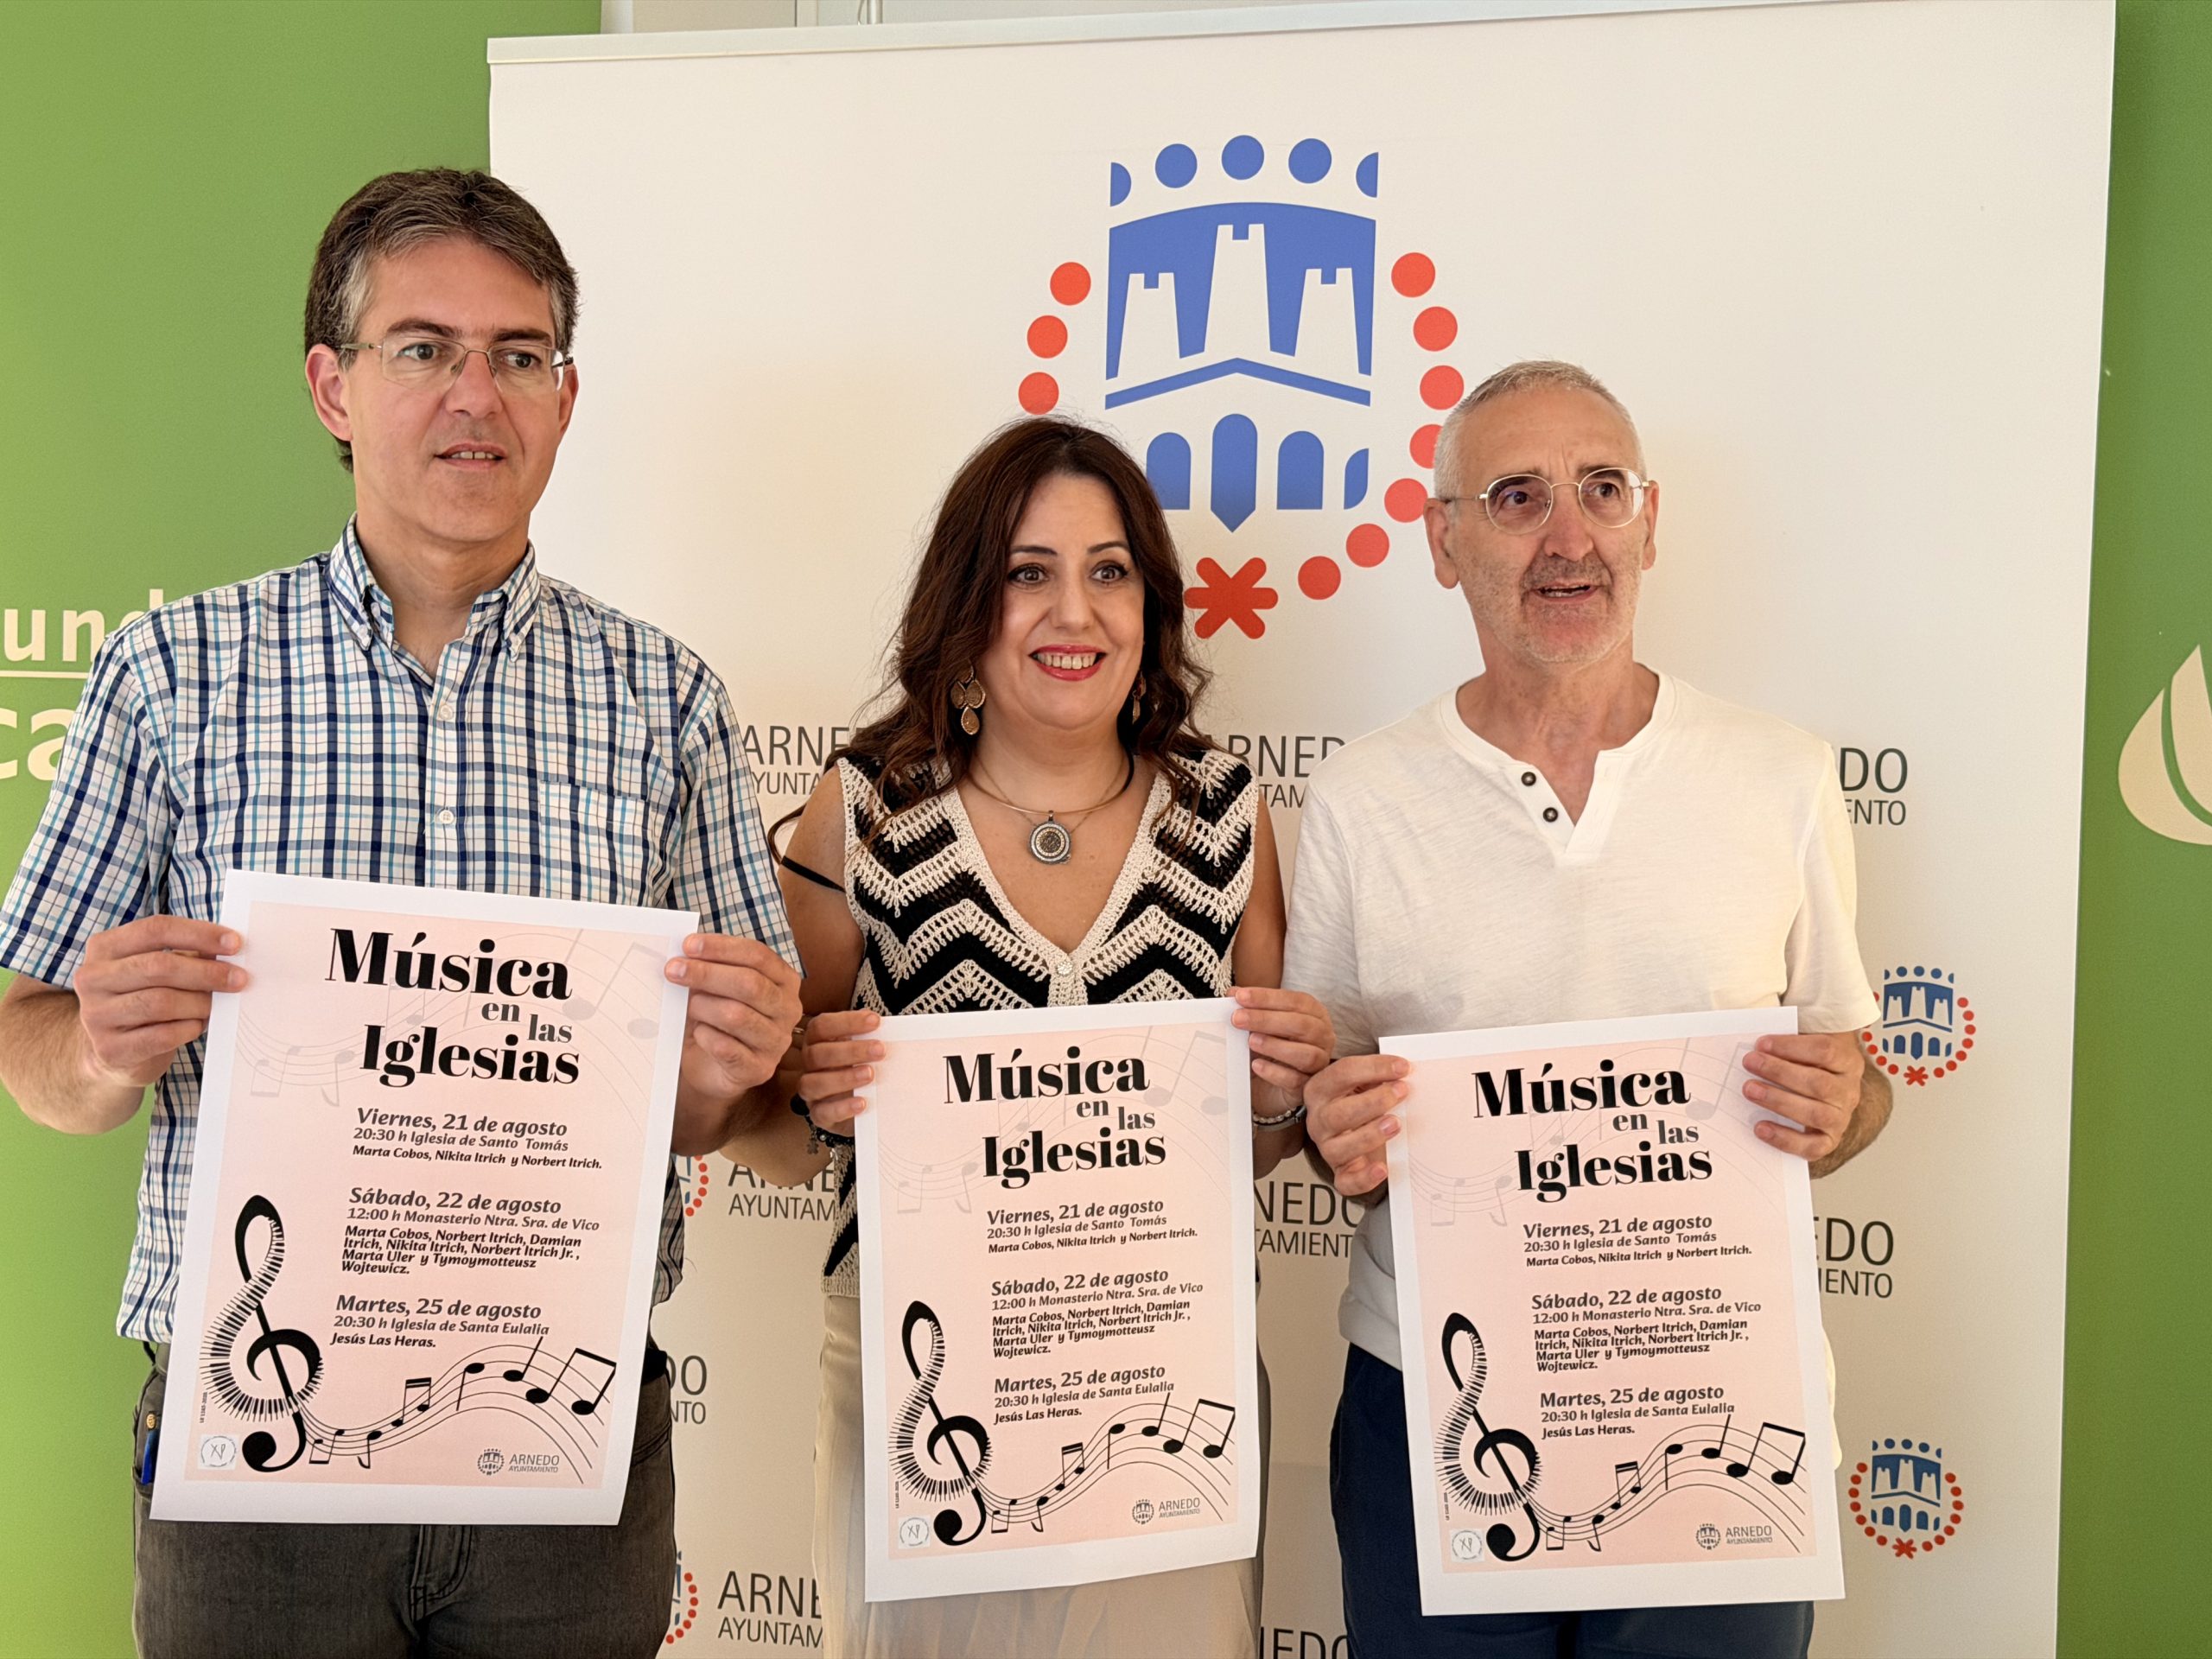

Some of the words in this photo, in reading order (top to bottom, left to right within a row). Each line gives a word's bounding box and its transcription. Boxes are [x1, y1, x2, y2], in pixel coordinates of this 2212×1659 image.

[743, 725, 868, 766] ARNE
[324, 928, 572, 1000] Música
[481, 1002, 519, 1021] en
[528, 1014, 571, 1043] las
[359, 1024, 579, 1087] Iglesias
[943, 1046, 1149, 1103] Música
[1471, 1058, 1690, 1118] Música
[356, 1107, 436, 1131] Viernes,
[442, 1113, 467, 1130] 21
[473, 1116, 498, 1132] de
[501, 1121, 567, 1141] agosto
[1076, 1100, 1109, 1117] en
[1117, 1106, 1154, 1129] las
[353, 1127, 395, 1141] 20:30
[397, 1130, 407, 1141] h
[410, 1131, 456, 1146] Iglesia
[459, 1134, 476, 1146] de
[478, 1135, 518, 1147] Santo
[525, 1138, 568, 1151] Tomás
[1612, 1113, 1647, 1131] en
[1657, 1119, 1698, 1144] las
[353, 1144, 391, 1156] Marta
[393, 1147, 431, 1161] Cobos,
[435, 1149, 472, 1161] Nikita
[474, 1152, 505, 1163] Itrich
[510, 1156, 518, 1166] y
[521, 1154, 566, 1166] Norbert
[569, 1157, 601, 1168] Itrich.
[982, 1126, 1166, 1189] Iglesias
[1515, 1141, 1712, 1203] Iglesias
[349, 1186, 430, 1210] Sábado,
[435, 1192, 462, 1208] 22
[467, 1193, 492, 1210] de
[495, 1198, 561, 1216] agosto
[987, 1209, 1053, 1225] Viernes,
[1058, 1204, 1080, 1219] 21
[1084, 1202, 1104, 1217] de
[1109, 1200, 1163, 1218] agosto
[346, 1207, 388, 1220] 12:00
[391, 1209, 400, 1221] h
[404, 1210, 480, 1224] Monasterio
[484, 1213, 518, 1226] Ntra.
[521, 1216, 547, 1228] Sra.
[551, 1217, 568, 1229] de
[572, 1218, 599, 1230] Vico
[987, 1226, 1020, 1238] 20:30
[1024, 1225, 1031, 1236] h
[1034, 1222, 1071, 1237] Iglesia
[1074, 1221, 1088, 1231] de
[1090, 1219, 1124, 1230] Santo
[1129, 1214, 1166, 1227] Tomás
[1522, 1223, 1595, 1236] Viernes,
[1599, 1218, 1622, 1234] 21
[1626, 1217, 1648, 1232] de
[1652, 1216, 1712, 1234] agosto
[343, 1236, 382, 1251] Itrich,
[385, 1238, 427, 1251] Nikita
[429, 1240, 467, 1255] Itrich,
[470, 1243, 521, 1255] Norbert
[524, 1244, 558, 1257] Itrich
[345, 1224, 386, 1237] Marta
[387, 1227, 431, 1243] Cobos,
[435, 1229, 486, 1243] Norbert
[488, 1231, 525, 1246] Itrich,
[526, 1233, 581, 1247] Damian
[1255, 1228, 1353, 1258] AMIENT
[1523, 1240, 1560, 1252] 20:30
[1562, 1239, 1570, 1249] h
[1573, 1236, 1613, 1251] Iglesia
[1616, 1236, 1631, 1247] de
[1634, 1235, 1670, 1245] Santo
[1675, 1231, 1716, 1243] Tomás
[1813, 1216, 1894, 1266] DO
[341, 1248, 384, 1261] Marta
[419, 1255, 429, 1266] y
[991, 1277, 1058, 1296] Sábado,
[1064, 1274, 1085, 1289] 22
[1089, 1272, 1109, 1287] de
[1113, 1269, 1168, 1288] agosto
[335, 1294, 410, 1317] Martes,
[415, 1298, 442, 1314] 25
[447, 1299, 471, 1315] de
[475, 1305, 541, 1320] agosto
[992, 1297, 1026, 1310] 12:00
[1028, 1296, 1035, 1306] h
[1039, 1291, 1103, 1306] Monasterio
[1106, 1289, 1135, 1300] Ntra.
[1137, 1287, 1160, 1297] Sra.
[1162, 1284, 1176, 1294] de
[1179, 1282, 1203, 1293] Vico
[1531, 1292, 1603, 1311] Sábado,
[1608, 1289, 1631, 1305] 22
[1636, 1288, 1656, 1303] de
[1661, 1287, 1721, 1306] agosto
[1533, 1312, 1568, 1324] 12:00
[1571, 1311, 1579, 1321] h
[1582, 1306, 1651, 1320] Monasterio
[1654, 1306, 1685, 1317] Ntra.
[1688, 1304, 1713, 1315] Sra.
[1716, 1302, 1731, 1313] de
[1734, 1301, 1761, 1312] Vico
[334, 1315, 375, 1328] 20:30
[378, 1316, 387, 1328] h
[391, 1318, 436, 1332] Iglesia
[439, 1319, 456, 1332] de
[458, 1320, 499, 1332] Santa
[502, 1322, 549, 1336] Eulalia
[329, 1332, 365, 1345] Jesús
[368, 1333, 391, 1345] Las
[394, 1335, 435, 1347] Heras.
[994, 1377, 1056, 1393] Martes,
[1060, 1370, 1082, 1387] 25
[1086, 1369, 1106, 1384] de
[1110, 1366, 1165, 1384] agosto
[1540, 1392, 1605, 1409] Martes,
[1610, 1388, 1633, 1403] 25
[1637, 1387, 1659, 1402] de
[1663, 1386, 1724, 1404] agosto
[1541, 1410, 1577, 1422] 20:30
[1580, 1409, 1587, 1421] h
[1591, 1408, 1630, 1422] Iglesia
[1634, 1407, 1649, 1417] de
[1651, 1406, 1688, 1416] Santa
[1691, 1402, 1734, 1415] Eulalia
[509, 1453, 559, 1465] ARNEDO
[1158, 1497, 1199, 1511] ARNEDO
[1726, 1525, 1771, 1537] ARNEDO
